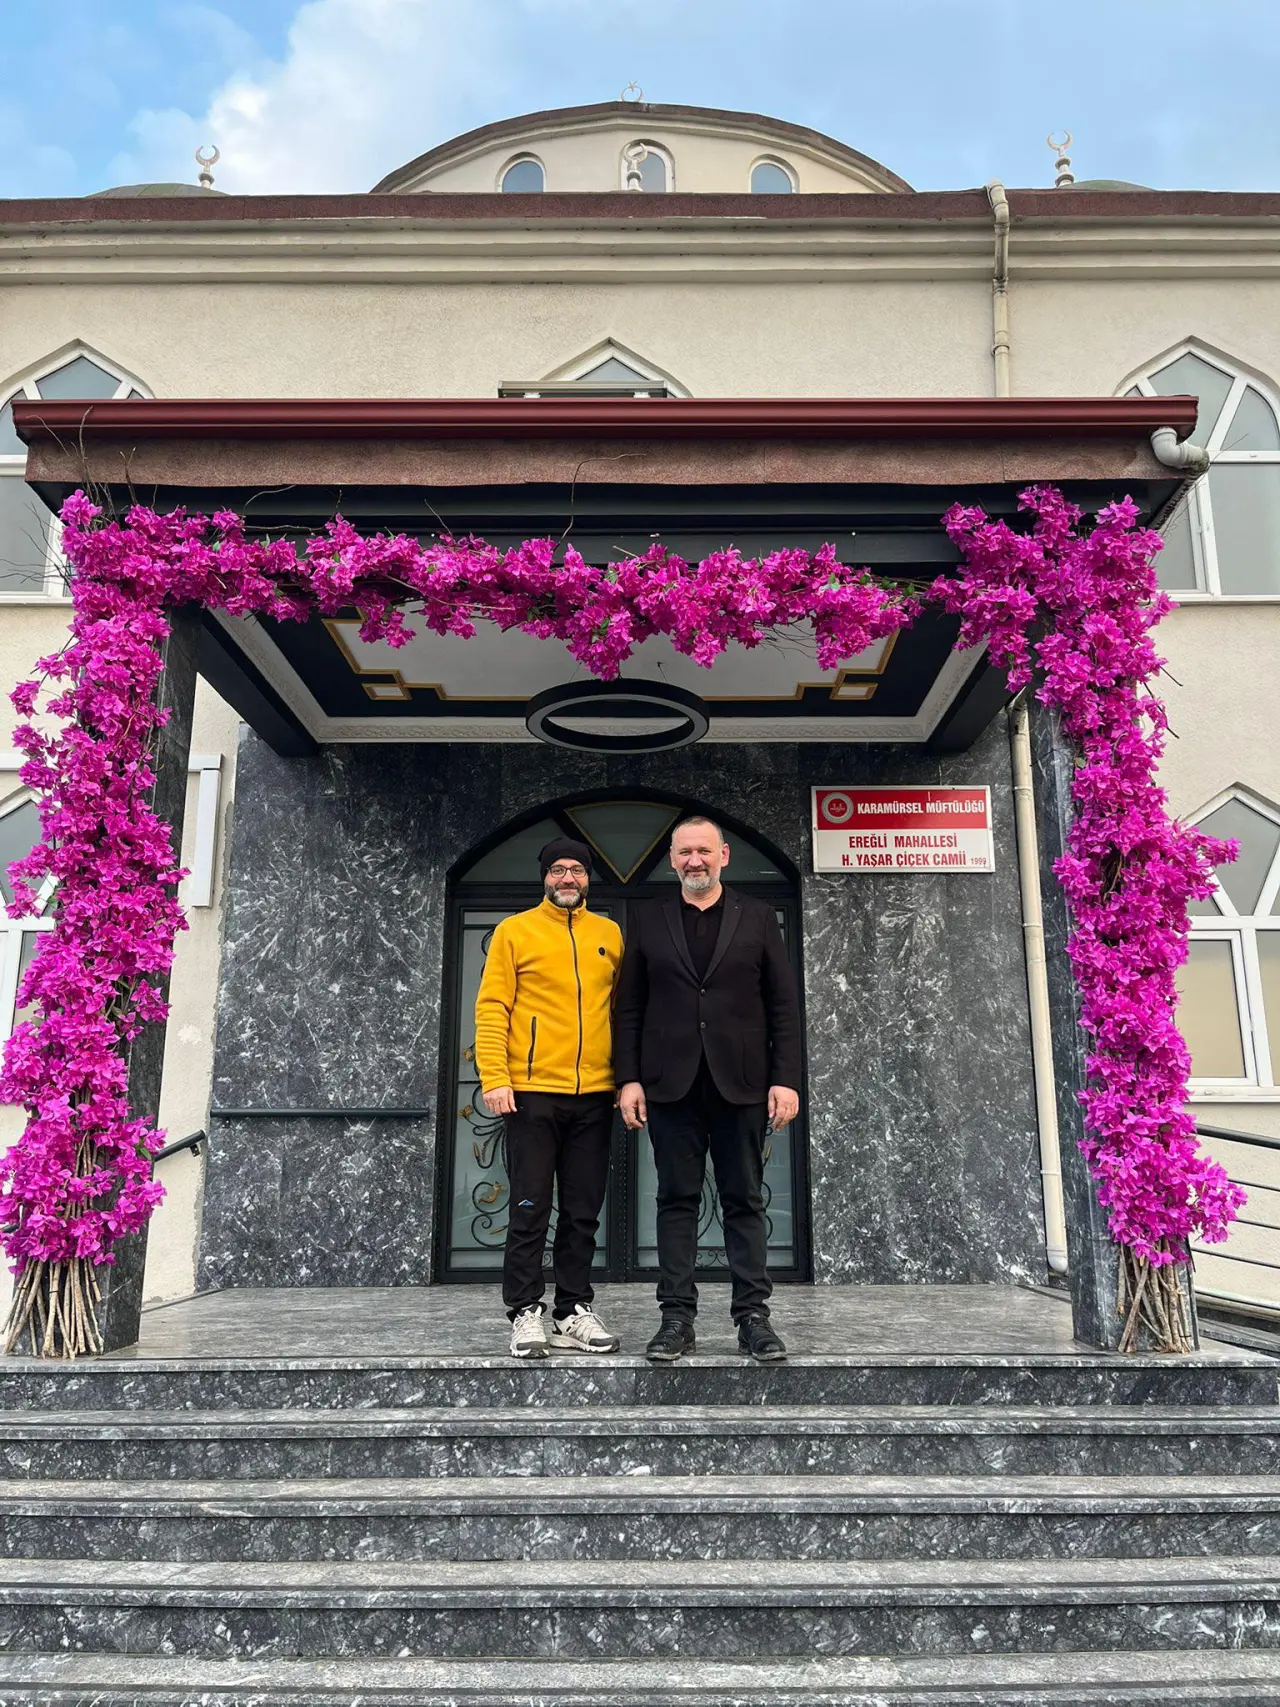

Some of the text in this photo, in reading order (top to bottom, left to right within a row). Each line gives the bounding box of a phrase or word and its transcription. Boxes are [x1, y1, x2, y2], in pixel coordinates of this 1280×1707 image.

[857, 801, 924, 814] KARAMÜRSEL
[926, 799, 985, 814] MÜFTÜLÜĞÜ
[849, 832, 958, 848] EREĞLİ MAHALLESİ
[842, 852, 966, 867] H. YAŞAR ÇİÇEK CAMİİ
[970, 857, 987, 865] 1999
